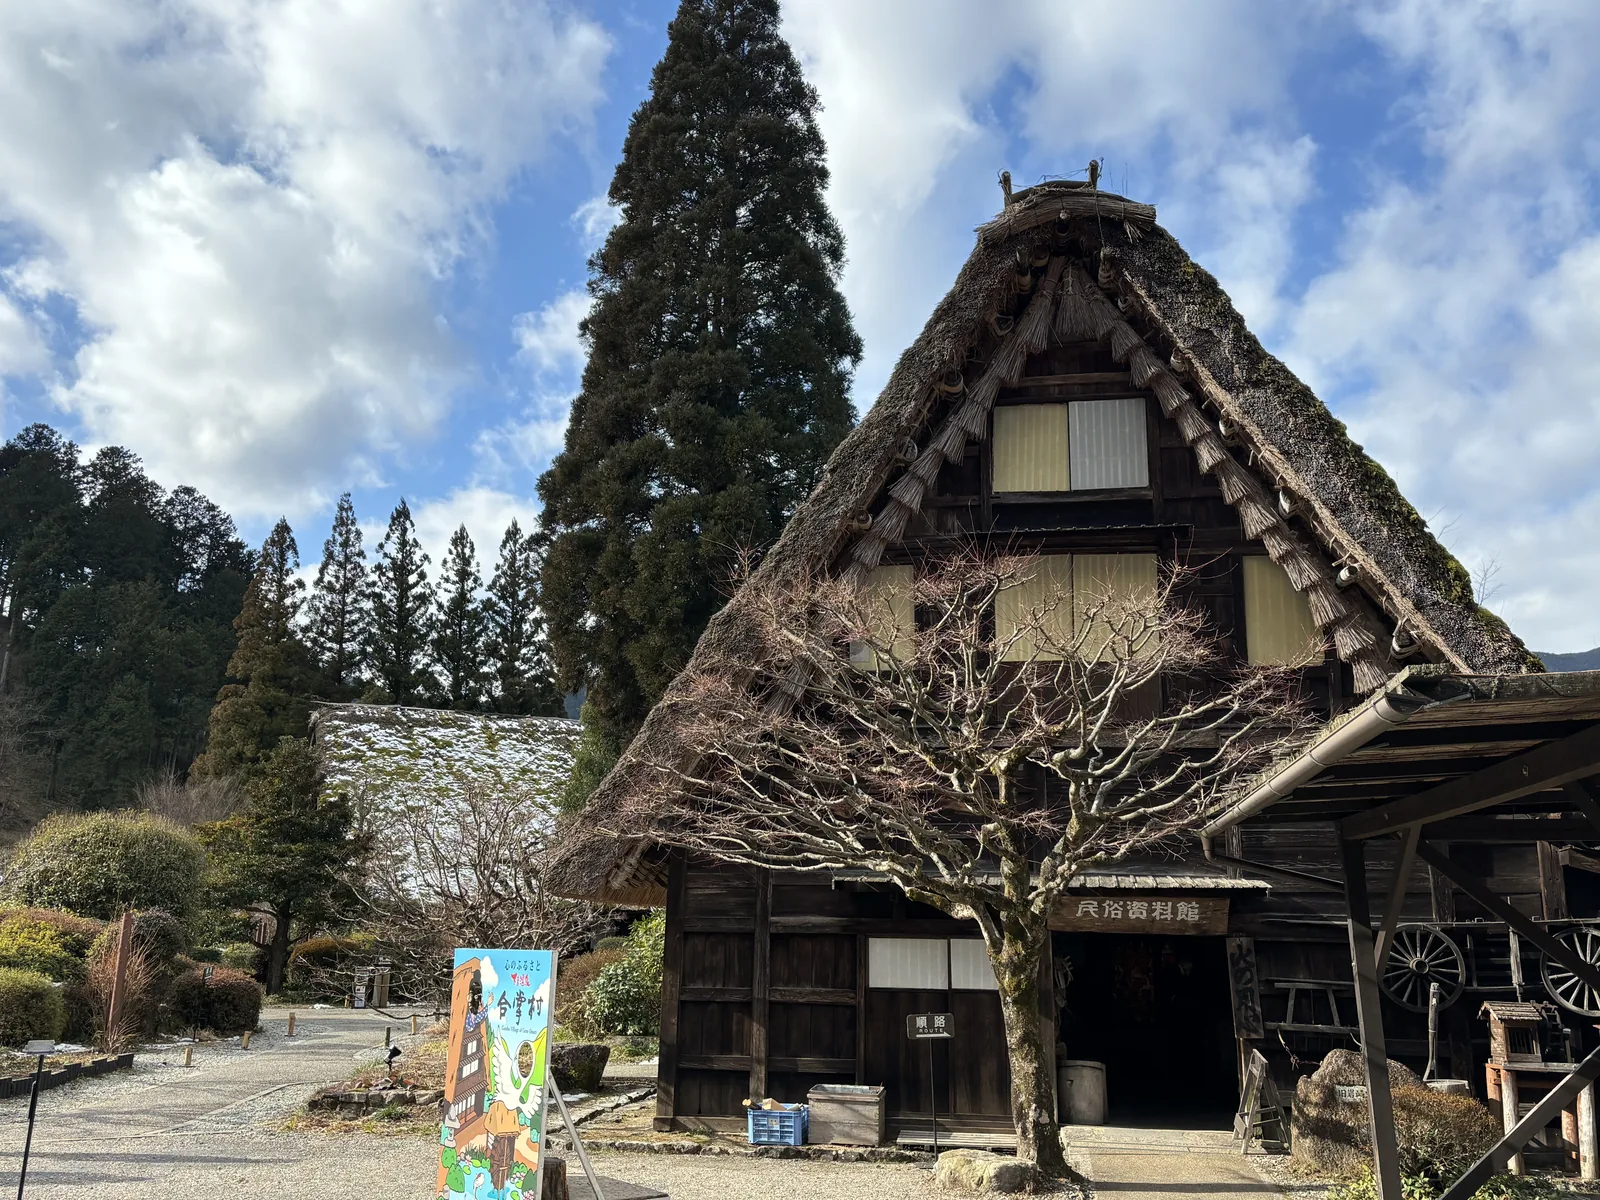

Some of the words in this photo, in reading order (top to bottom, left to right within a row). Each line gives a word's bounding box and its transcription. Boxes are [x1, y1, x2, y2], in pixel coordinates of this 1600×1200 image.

[1076, 899, 1200, 921] 民俗資料館
[505, 960, 541, 971] 心のふるさと
[497, 989, 543, 1026] 合掌村
[916, 1016, 945, 1028] 順路
